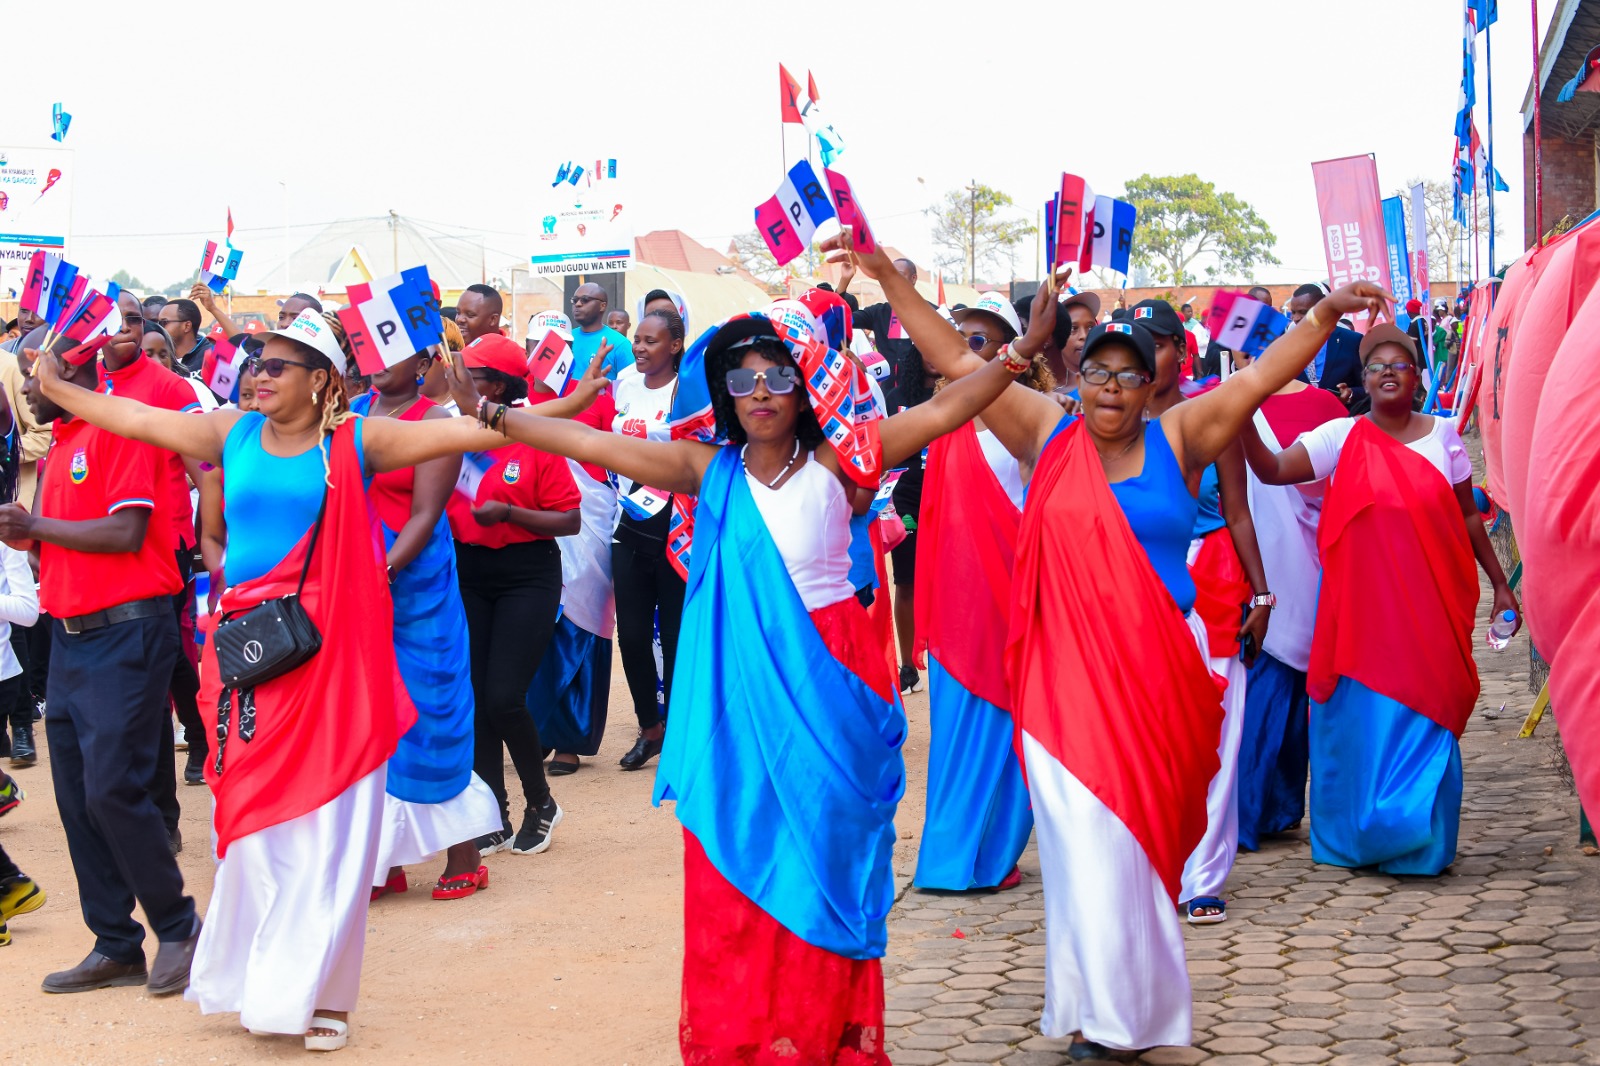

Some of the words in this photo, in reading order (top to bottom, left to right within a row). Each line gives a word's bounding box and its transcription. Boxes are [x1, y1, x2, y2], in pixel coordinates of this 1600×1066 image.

[215, 255, 224, 265] P
[228, 260, 239, 271] R
[537, 262, 589, 274] UMUDUGUDU
[591, 262, 604, 270] WA
[606, 260, 627, 269] NETE
[376, 320, 396, 346] P
[406, 306, 430, 330] R
[538, 346, 555, 361] F
[556, 361, 566, 374] P
[874, 367, 882, 376] P
[642, 496, 654, 506] P
